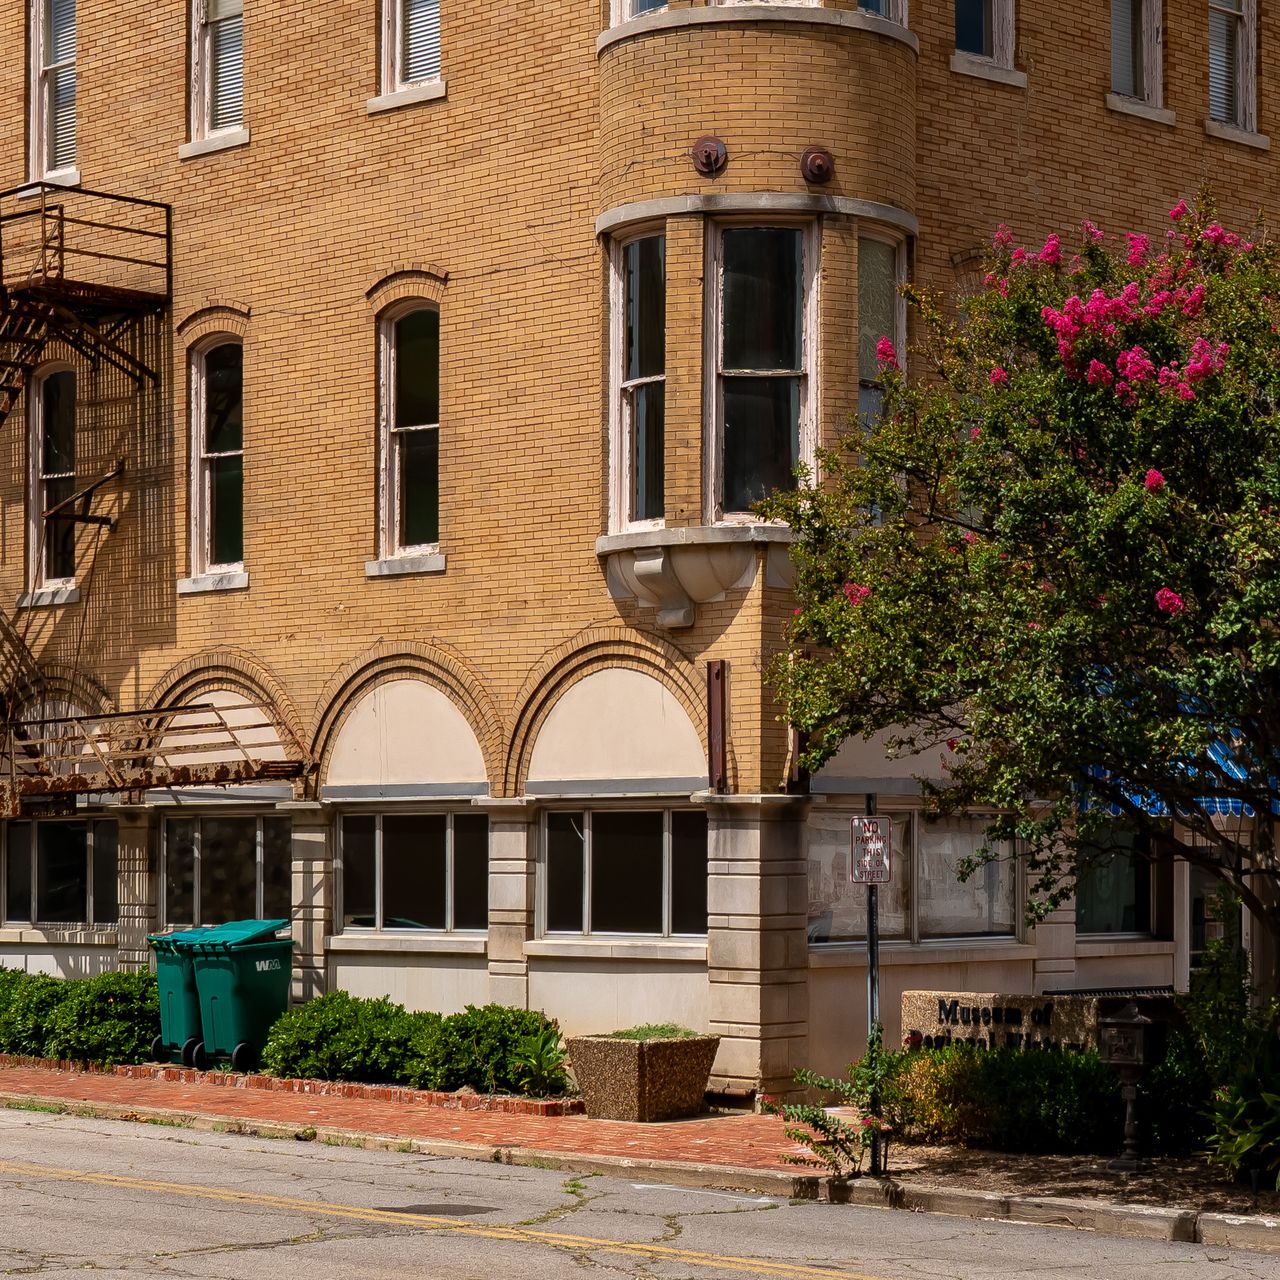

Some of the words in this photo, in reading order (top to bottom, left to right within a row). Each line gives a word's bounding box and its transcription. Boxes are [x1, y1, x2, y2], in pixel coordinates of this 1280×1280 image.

[863, 821, 879, 833] NO
[855, 835, 887, 845] PARKING
[862, 847, 881, 857] THIS
[856, 859, 872, 868] SIDE
[875, 859, 885, 867] OF
[859, 870, 884, 879] STREET
[256, 959, 281, 971] WM
[938, 998, 1022, 1026] Museum
[1031, 1003, 1054, 1026] of
